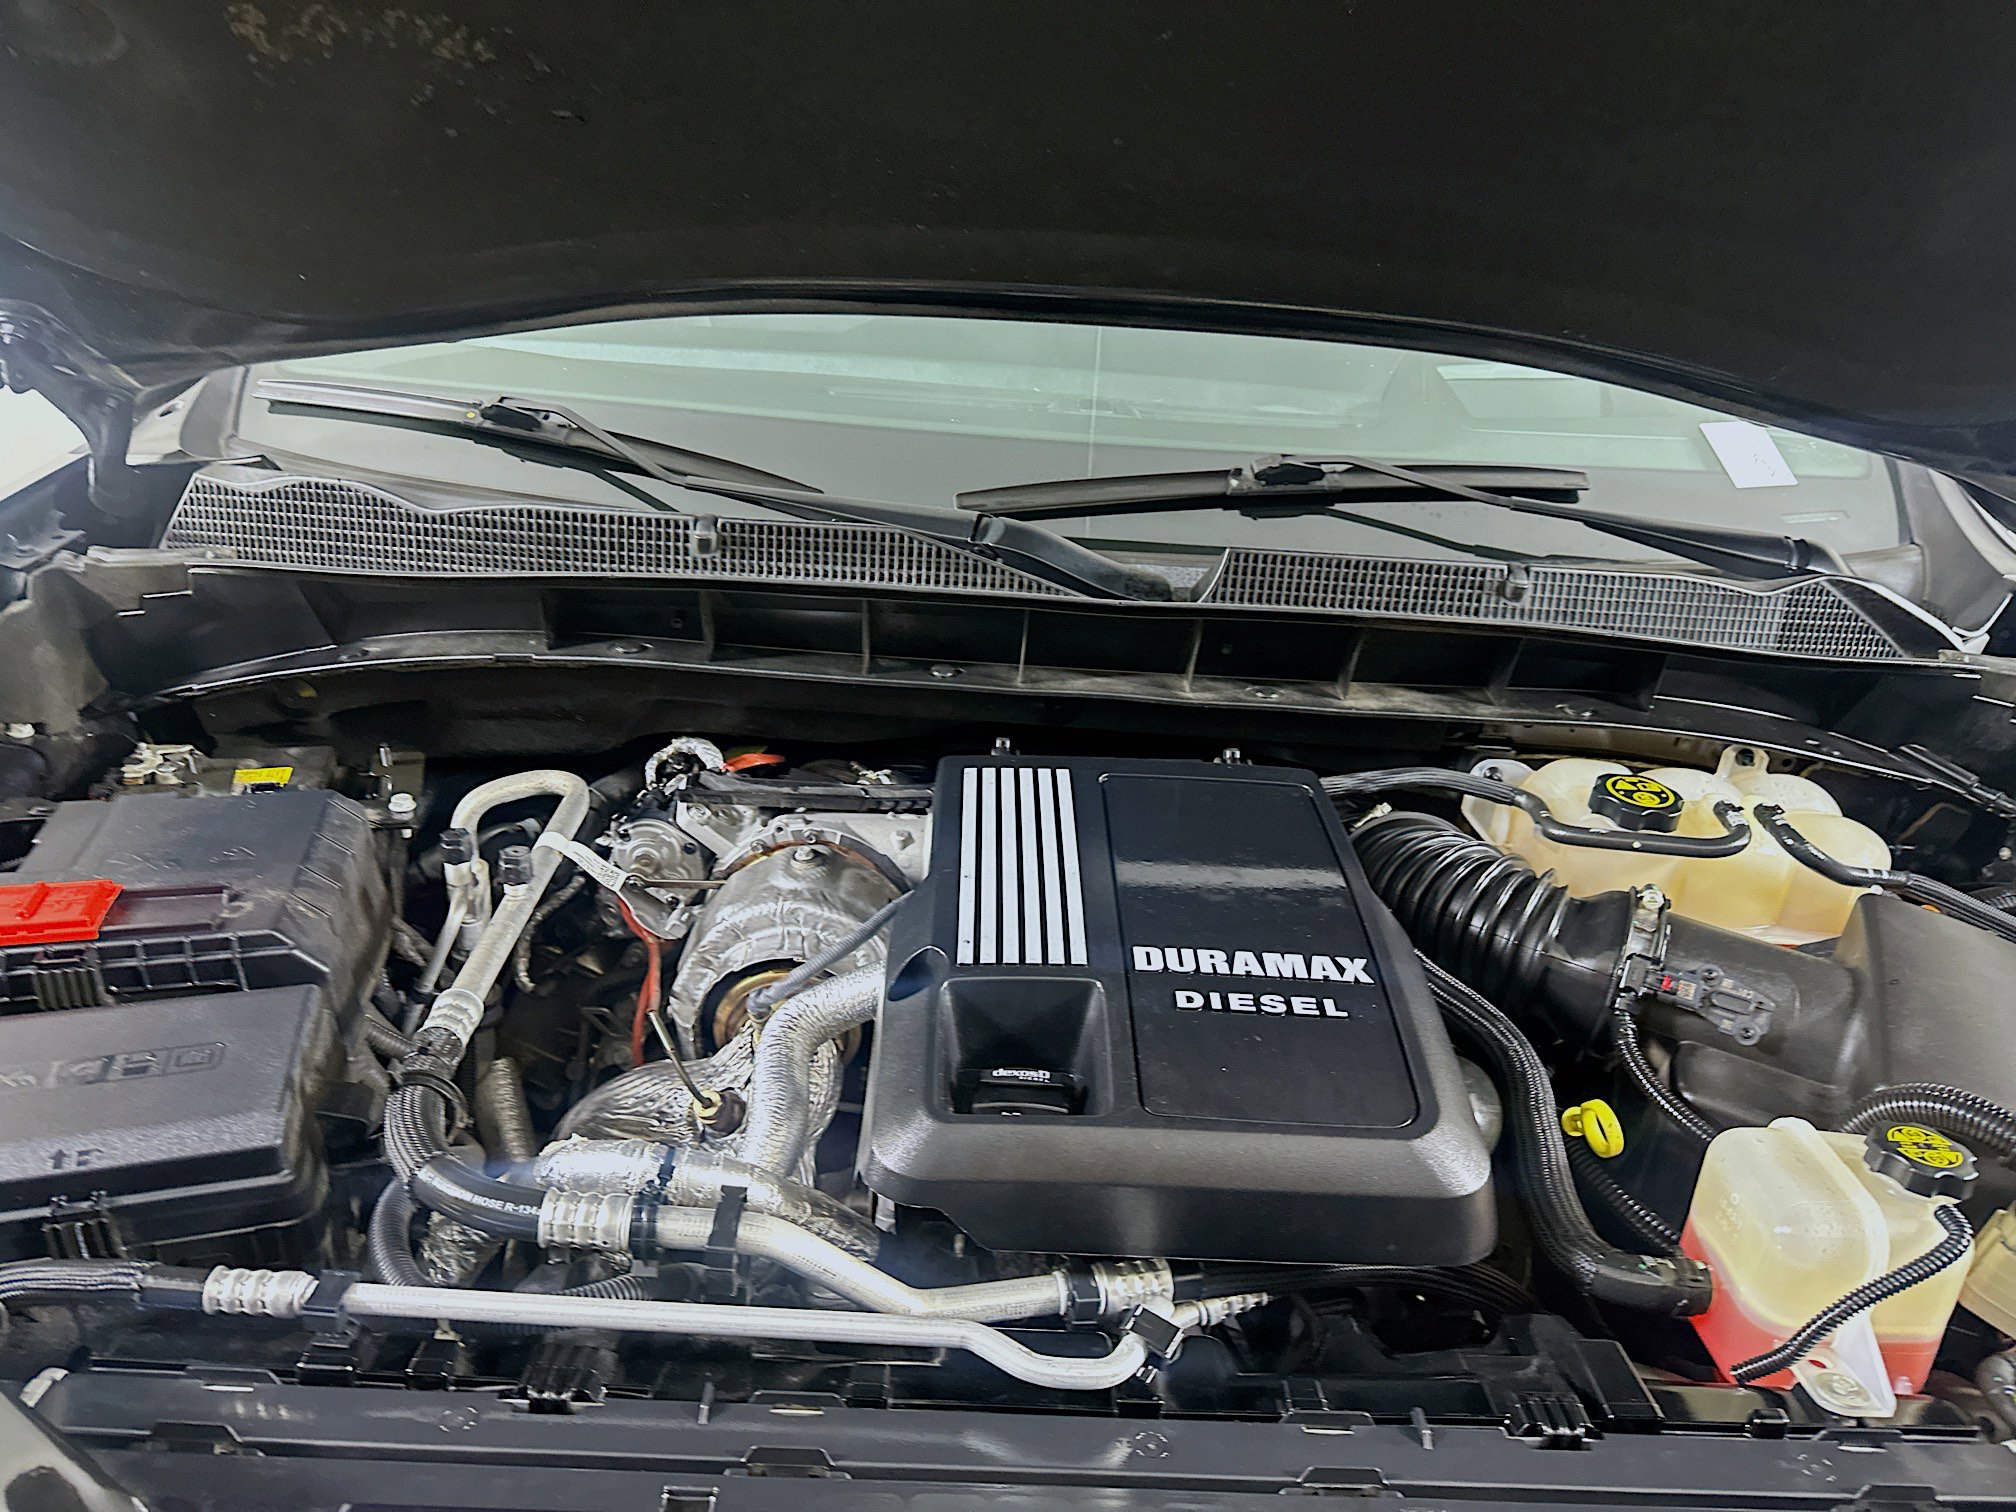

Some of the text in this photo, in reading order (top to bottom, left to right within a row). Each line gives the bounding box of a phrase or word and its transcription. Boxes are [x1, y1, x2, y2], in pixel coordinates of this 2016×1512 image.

[1132, 945, 1376, 985] DURAMAX
[1174, 990, 1350, 1019] DIESEL
[472, 1194, 505, 1211] HOSE
